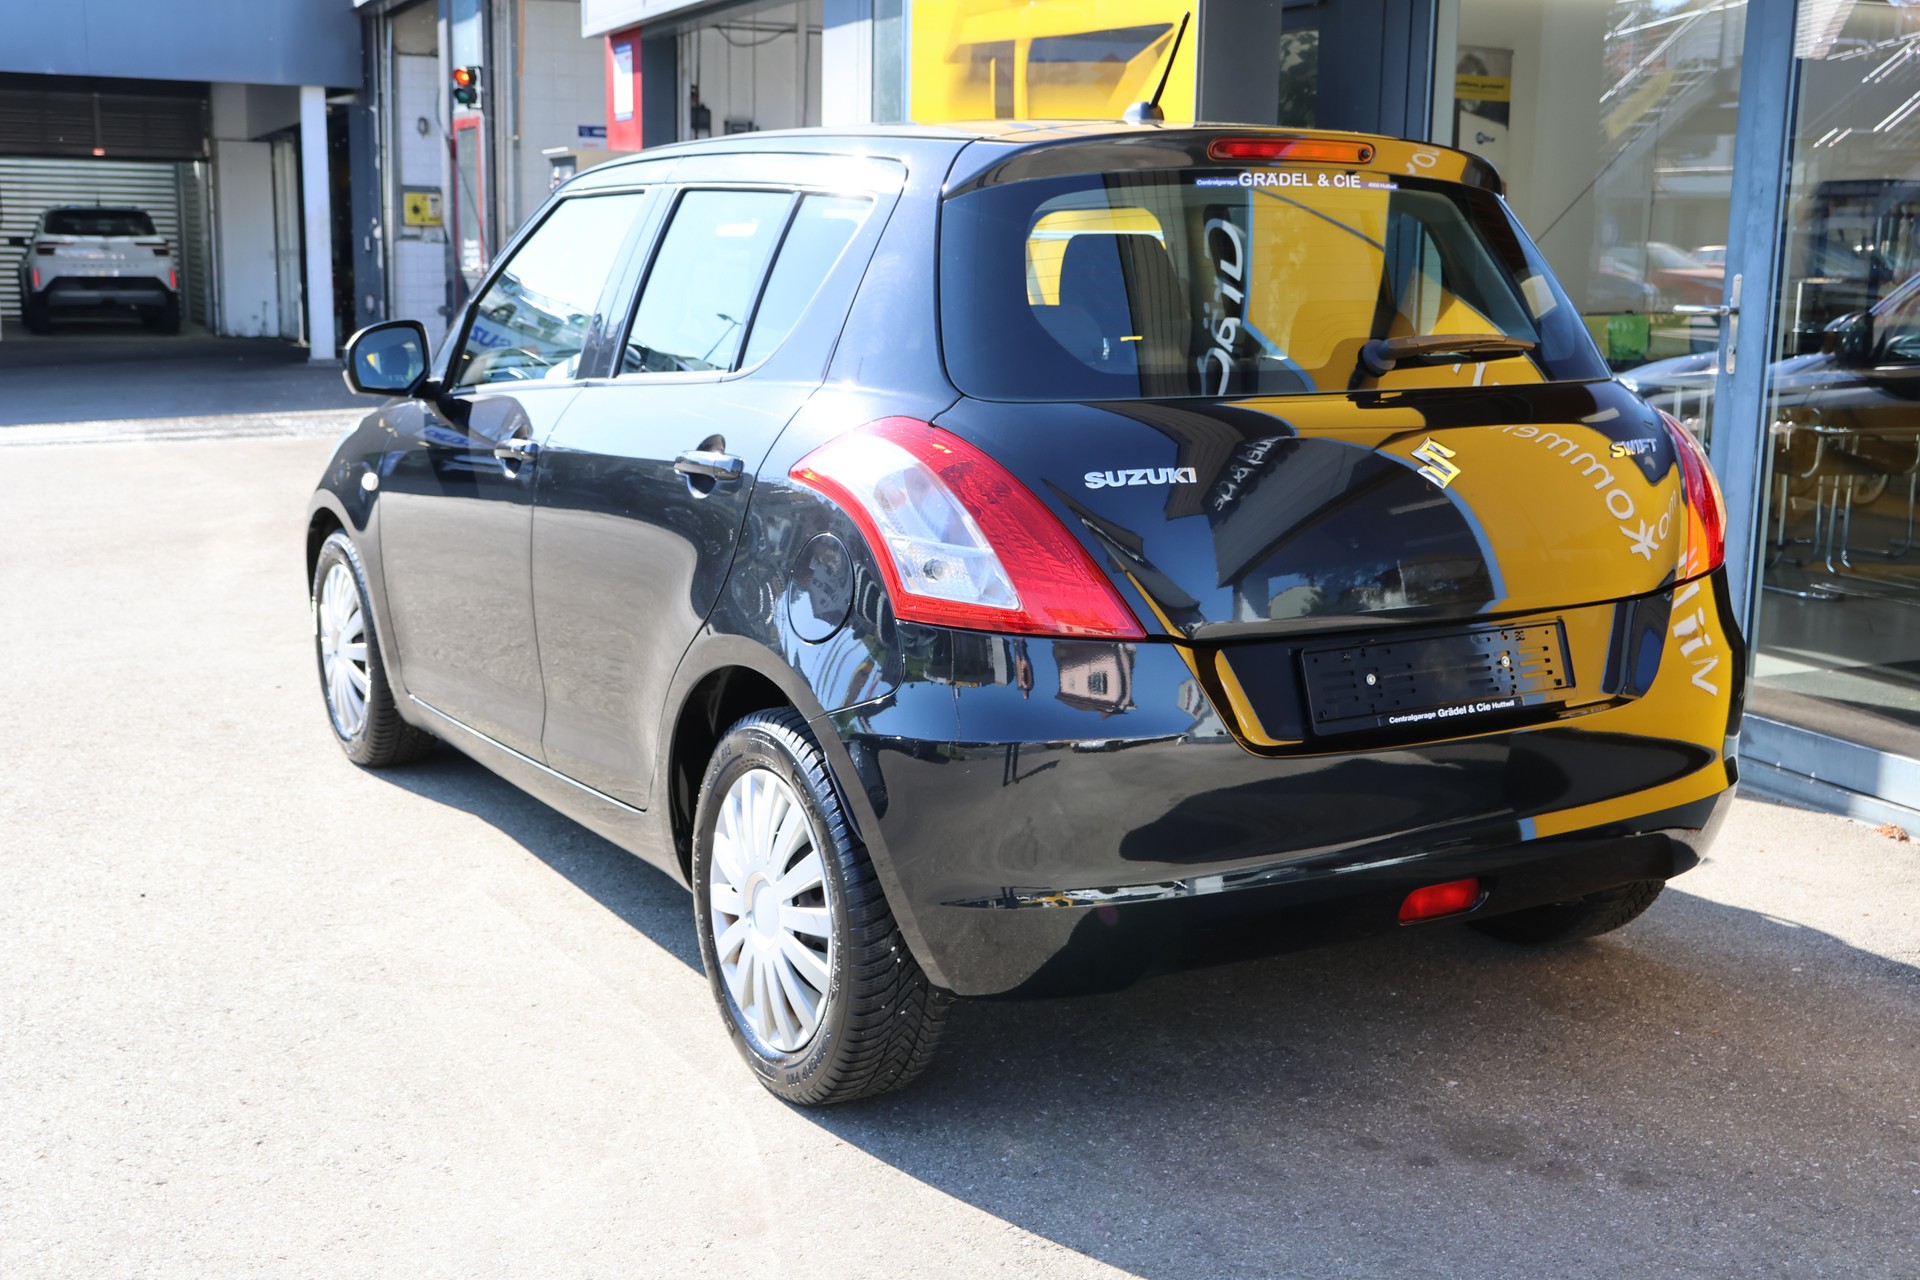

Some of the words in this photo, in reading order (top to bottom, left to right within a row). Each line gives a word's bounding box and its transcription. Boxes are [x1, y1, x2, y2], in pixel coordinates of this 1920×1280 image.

[1196, 179, 1239, 187] Centralgarage
[1238, 172, 1313, 187] GRÄDEL
[1317, 174, 1330, 187] &
[1333, 174, 1361, 188] CIE
[1610, 438, 1657, 458] SWIFT
[1084, 467, 1197, 489] SUZUKI
[1388, 712, 1436, 724] Centralgarage
[1437, 705, 1467, 718] Grädel
[1468, 704, 1475, 714] &
[1476, 702, 1491, 712] Cie
[1491, 699, 1515, 709] Huttwil
